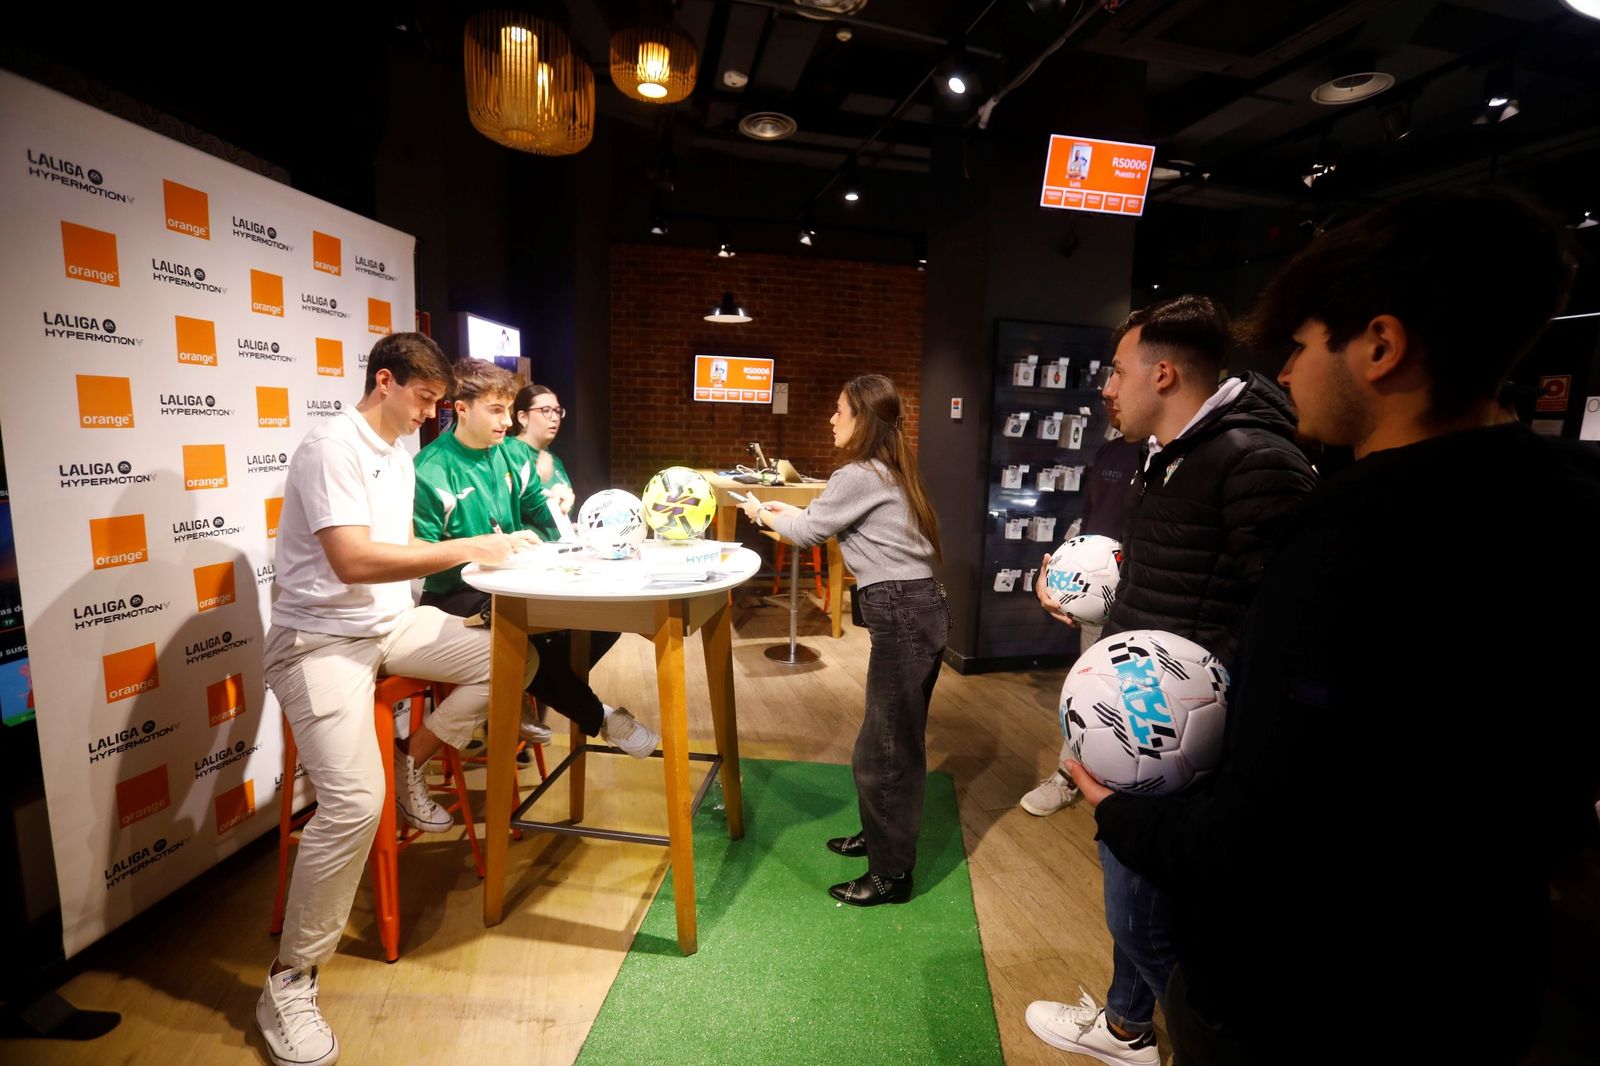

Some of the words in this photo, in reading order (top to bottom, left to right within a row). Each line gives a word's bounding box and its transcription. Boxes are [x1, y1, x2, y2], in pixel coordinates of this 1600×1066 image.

[27, 149, 84, 179] LALIGA
[1112, 157, 1148, 170] RS0006
[168, 218, 206, 236] orange
[233, 216, 265, 235] LALIGA
[152, 258, 191, 277] LALIGA
[315, 261, 338, 274] orange
[355, 255, 378, 270] LALIGA
[69, 265, 114, 283] orange
[302, 293, 328, 307] LALIGA
[253, 302, 282, 315] orange
[43, 312, 99, 330] LALIGA
[238, 338, 269, 352] LALIGA
[180, 352, 214, 365] orange
[318, 367, 342, 377] orange
[160, 394, 203, 406] LALIGA
[306, 400, 332, 409] LALIGA
[83, 414, 130, 427] orange
[259, 417, 287, 426] orange
[247, 454, 277, 465] LALIGA
[59, 463, 114, 477] LALIGA
[248, 465, 289, 474] HYPERMOT
[187, 477, 225, 488] orange
[173, 519, 210, 534] LALIGA
[96, 550, 143, 566] orange
[257, 564, 275, 577] LALI
[200, 593, 232, 608] orange
[74, 599, 126, 620] LALIGA
[186, 636, 220, 656] LALIGA
[109, 677, 154, 699] orange
[211, 705, 243, 724] orange
[89, 727, 139, 754] LALIGA
[195, 747, 233, 771] LALIGA
[122, 799, 168, 825] orange
[105, 848, 150, 880] LALIGA
